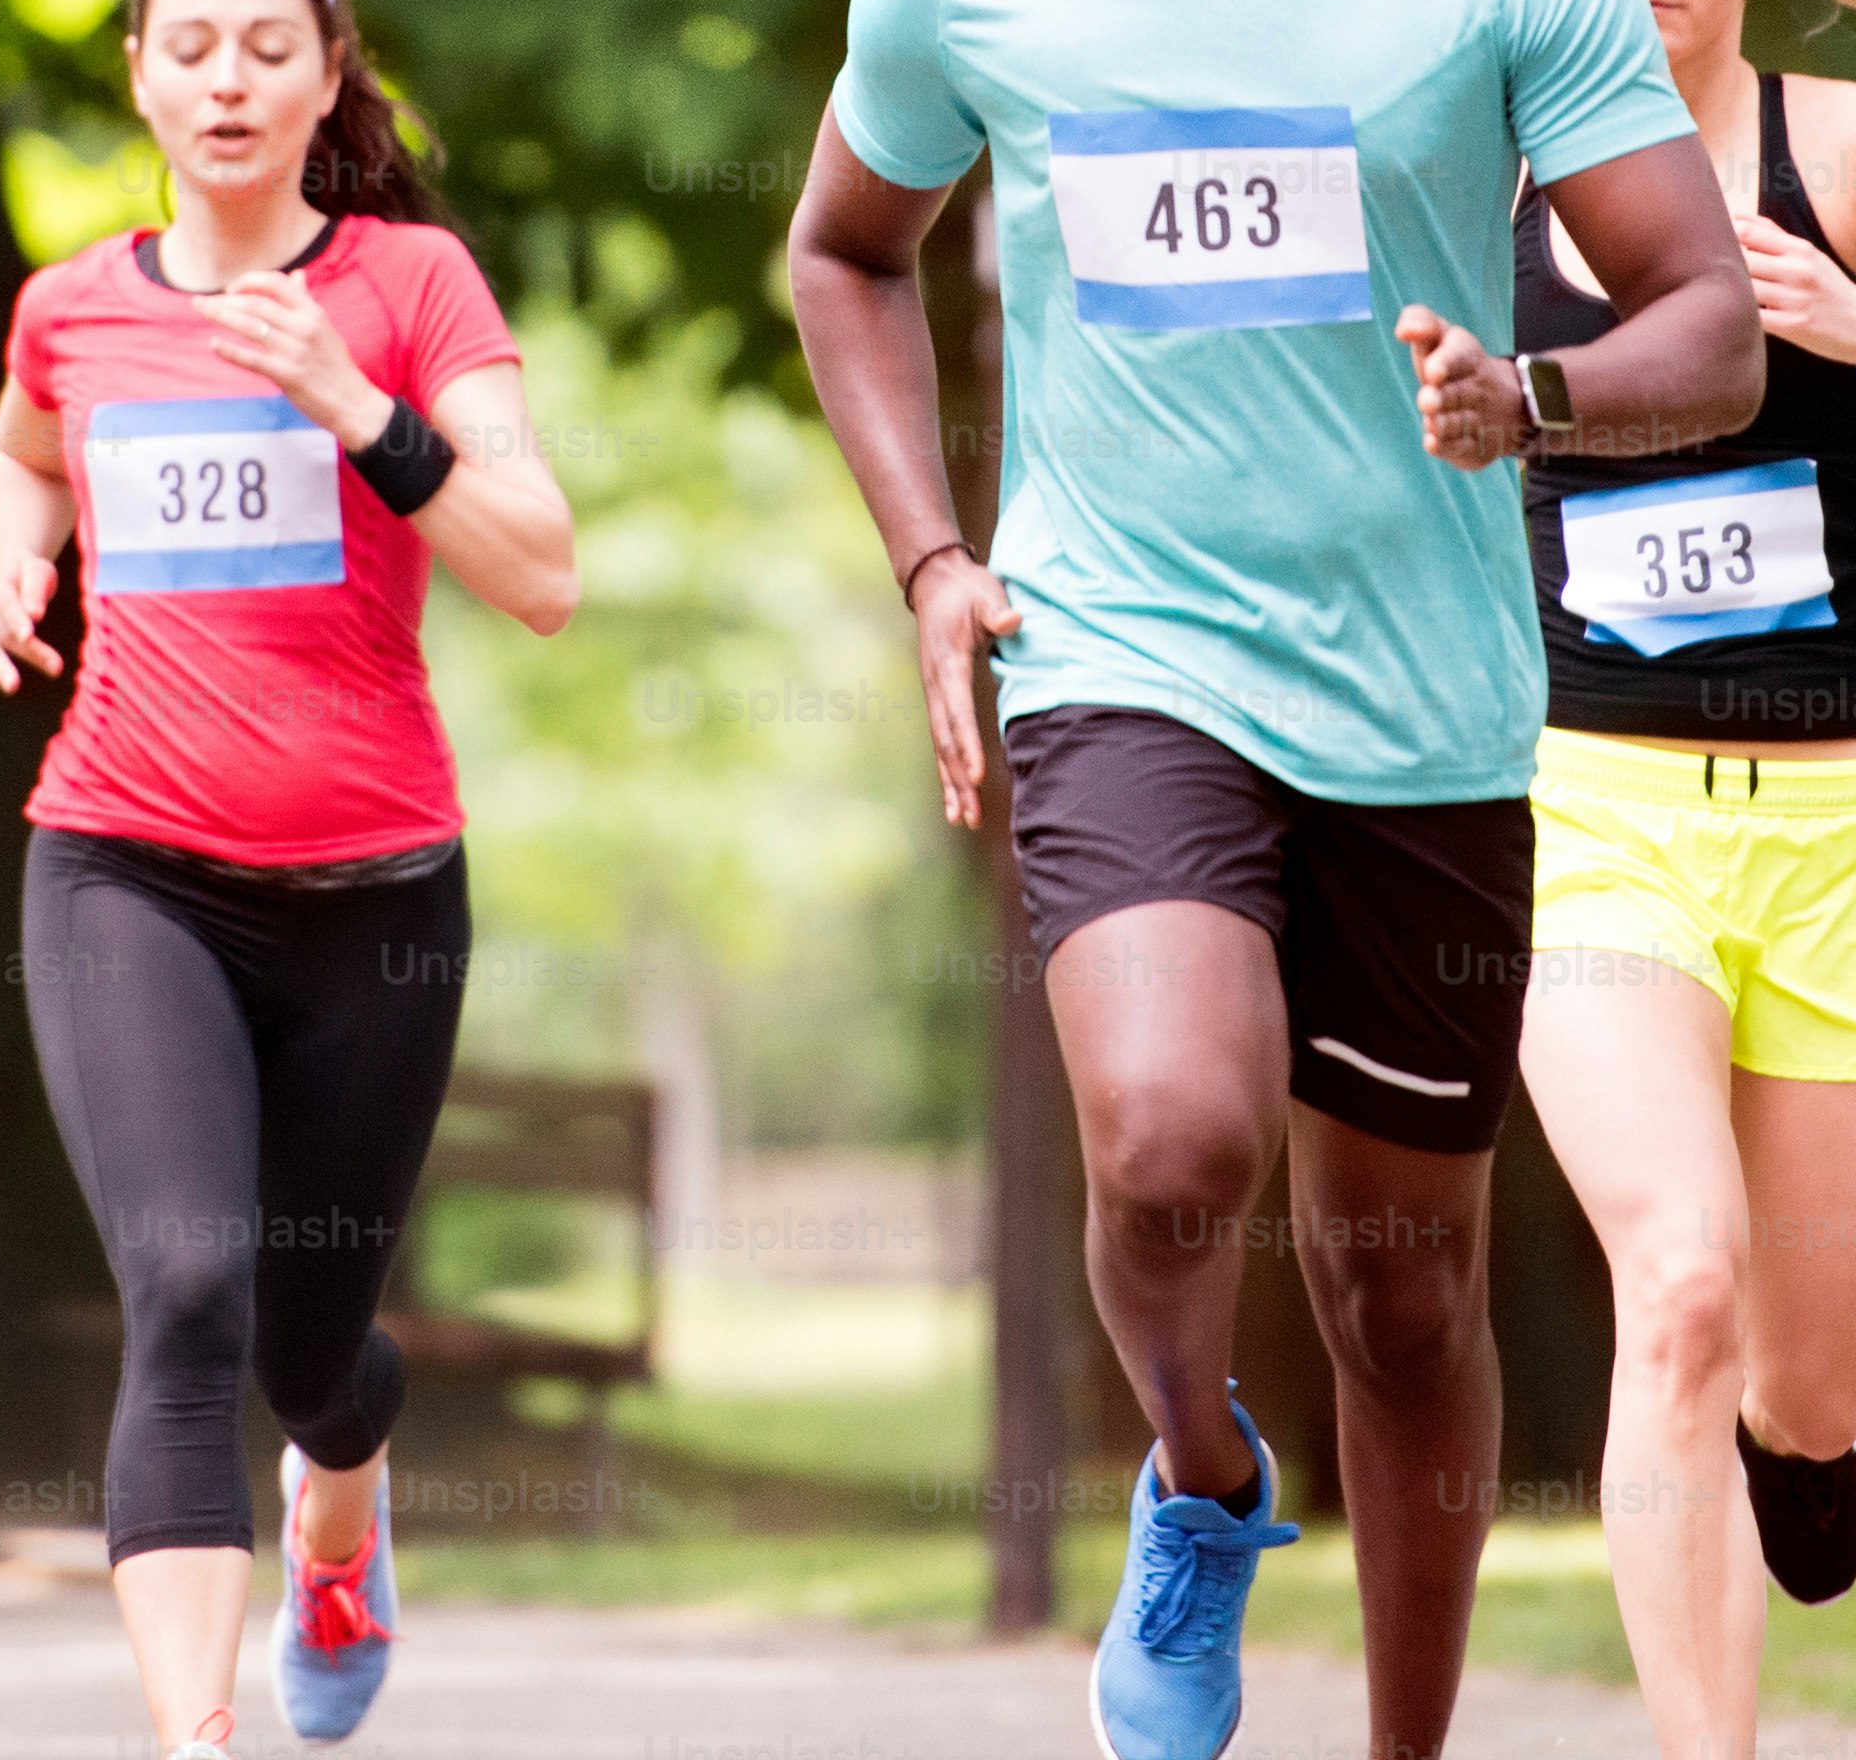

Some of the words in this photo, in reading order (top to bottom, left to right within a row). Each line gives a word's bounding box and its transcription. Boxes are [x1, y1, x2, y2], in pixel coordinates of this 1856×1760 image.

[1145, 176, 1281, 253] 463
[158, 458, 268, 523] 328
[1636, 522, 1756, 599] 353
